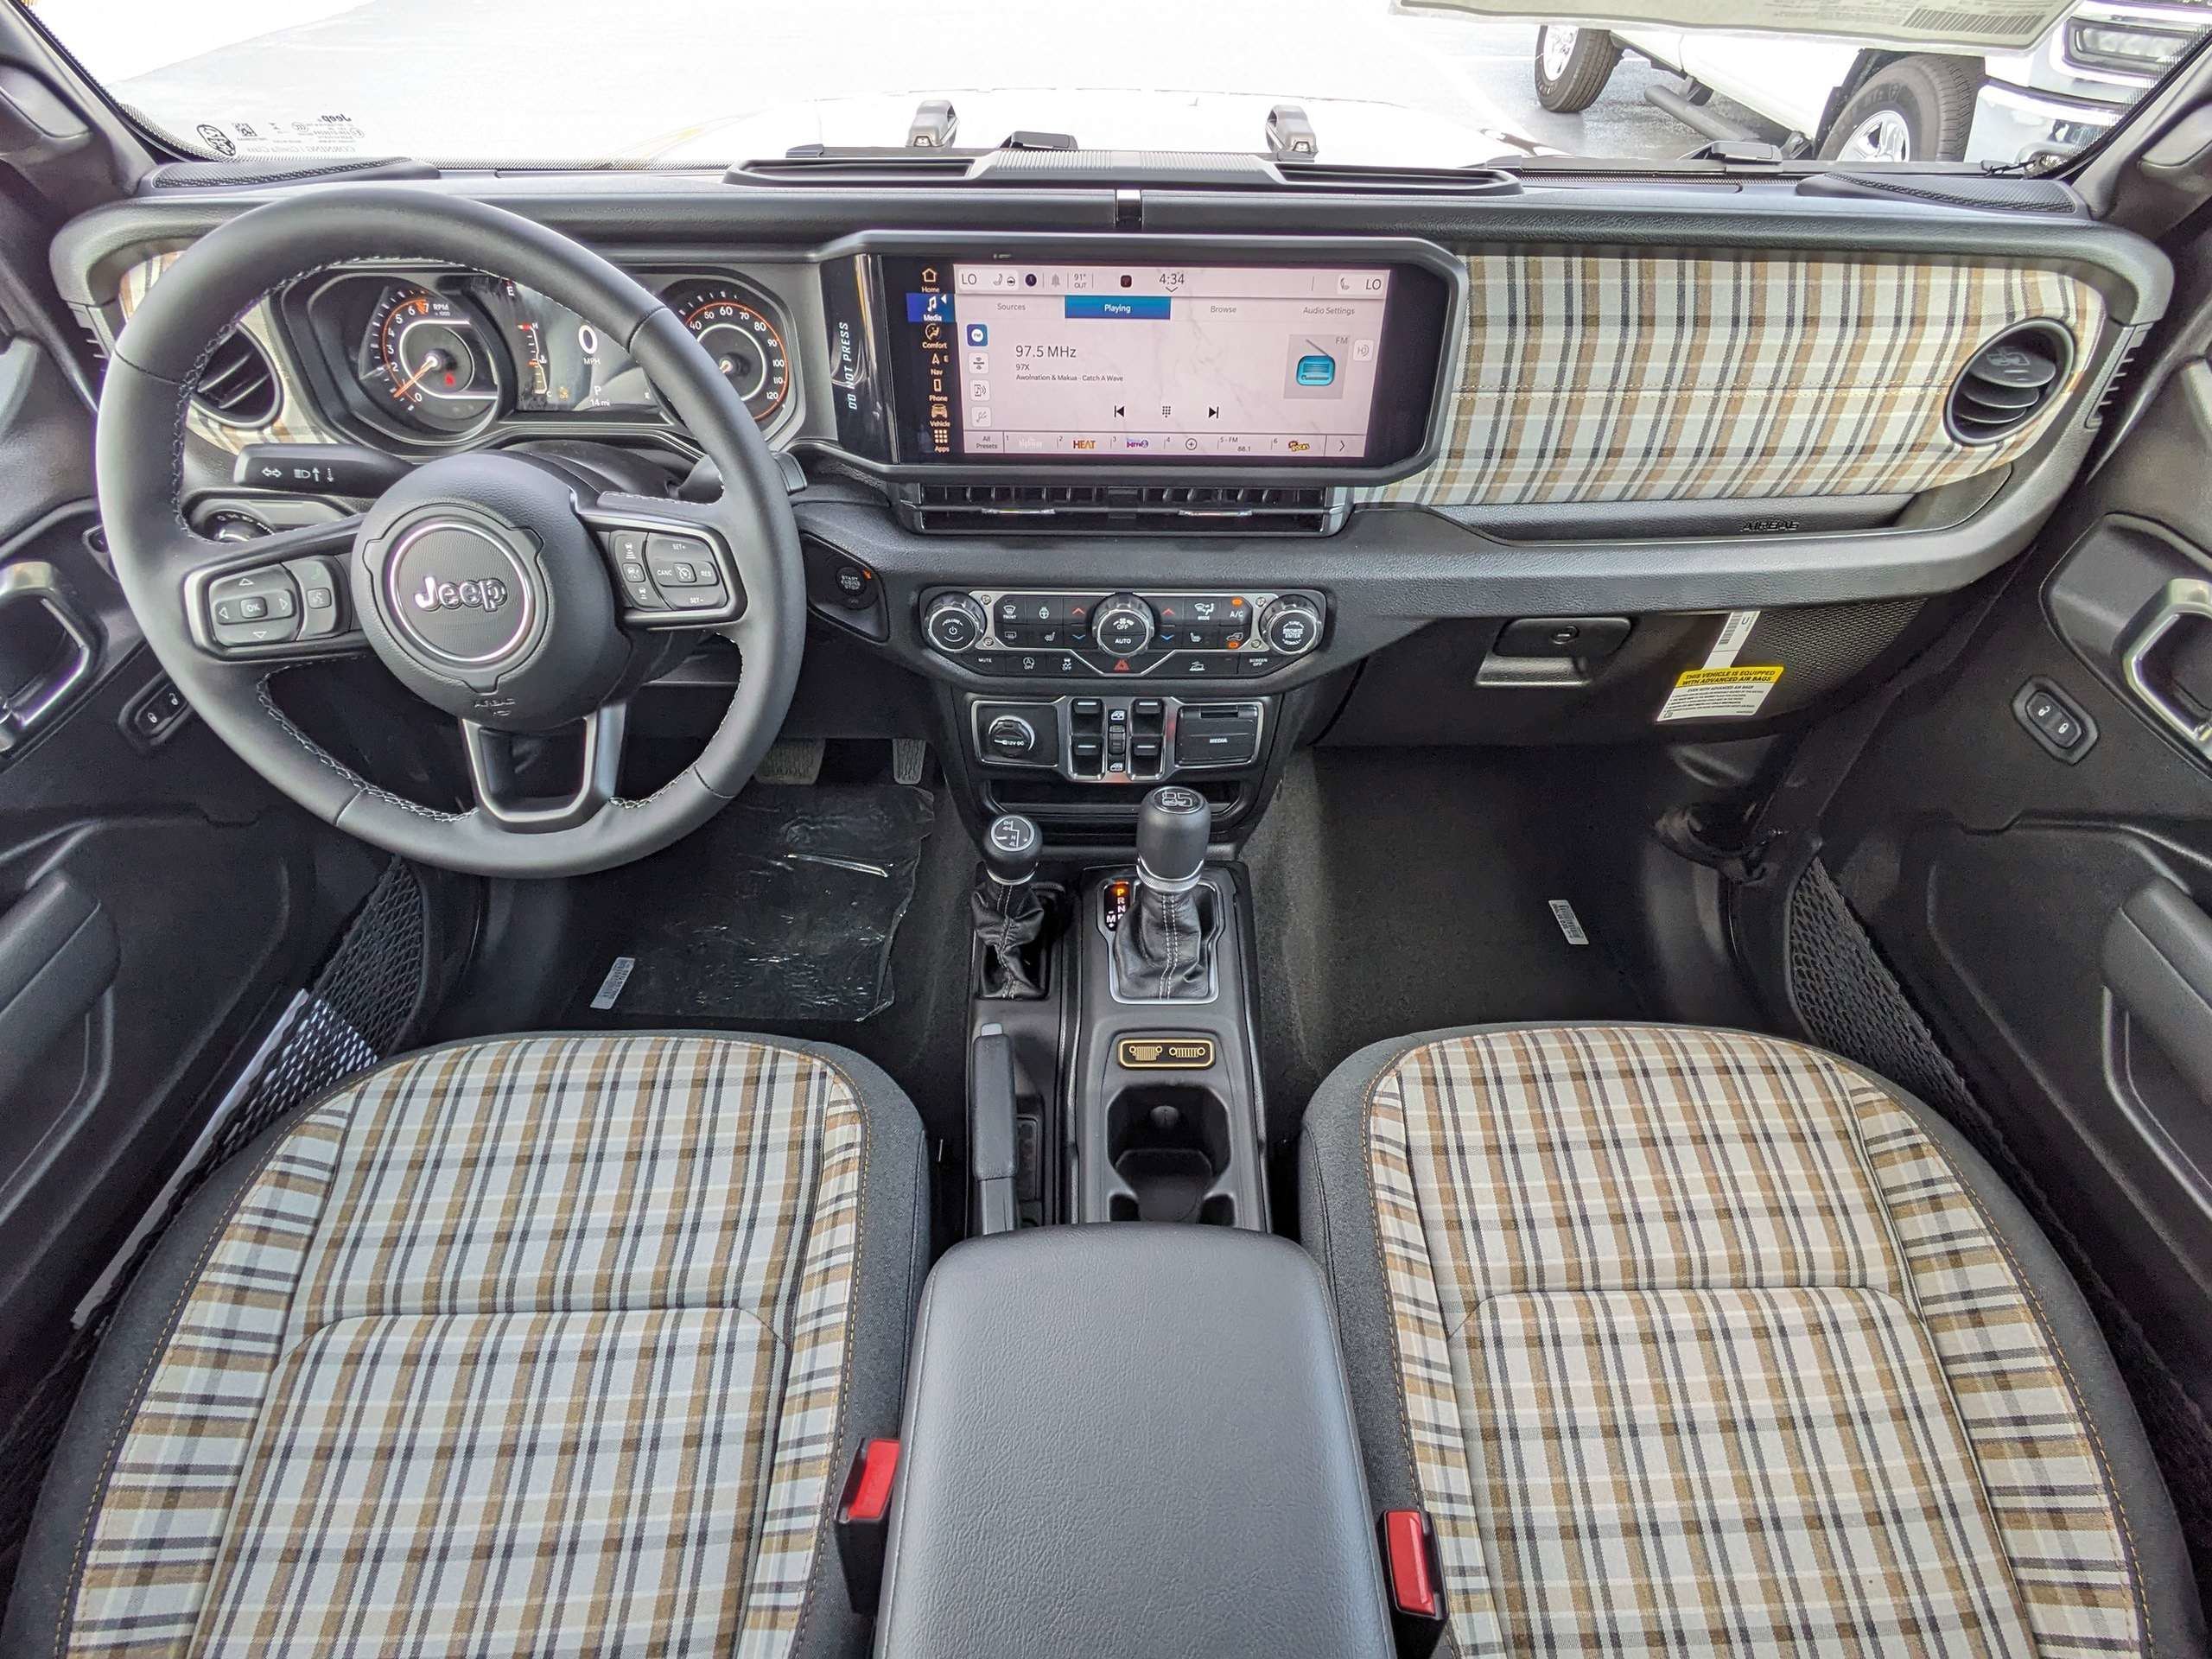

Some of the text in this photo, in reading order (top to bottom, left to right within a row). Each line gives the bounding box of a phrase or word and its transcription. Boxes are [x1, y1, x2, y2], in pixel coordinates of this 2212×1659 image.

[962, 273, 977, 285] LO
[1159, 273, 1185, 285] 4:34
[1365, 278, 1382, 290] LO
[507, 286, 514, 296] E
[408, 306, 415, 315] 6
[720, 307, 733, 316] 60
[1104, 304, 1131, 314] Playing
[1325, 307, 1355, 315] Settings
[396, 315, 403, 324] 5
[704, 311, 715, 320] 50
[690, 321, 702, 330] 40
[754, 321, 766, 332] 80
[388, 328, 395, 337] 4
[578, 324, 598, 354] 0
[767, 339, 778, 347] 90
[386, 345, 394, 354] 3
[1015, 346, 1077, 358] 97.5 MHz
[391, 362, 399, 372] 2
[839, 321, 857, 410] DO NOT PRESS
[594, 385, 601, 396] P
[415, 393, 422, 402] 0
[1073, 440, 1096, 449] HEAT
[415, 576, 508, 612] Jeep
[1106, 914, 1116, 923] M
